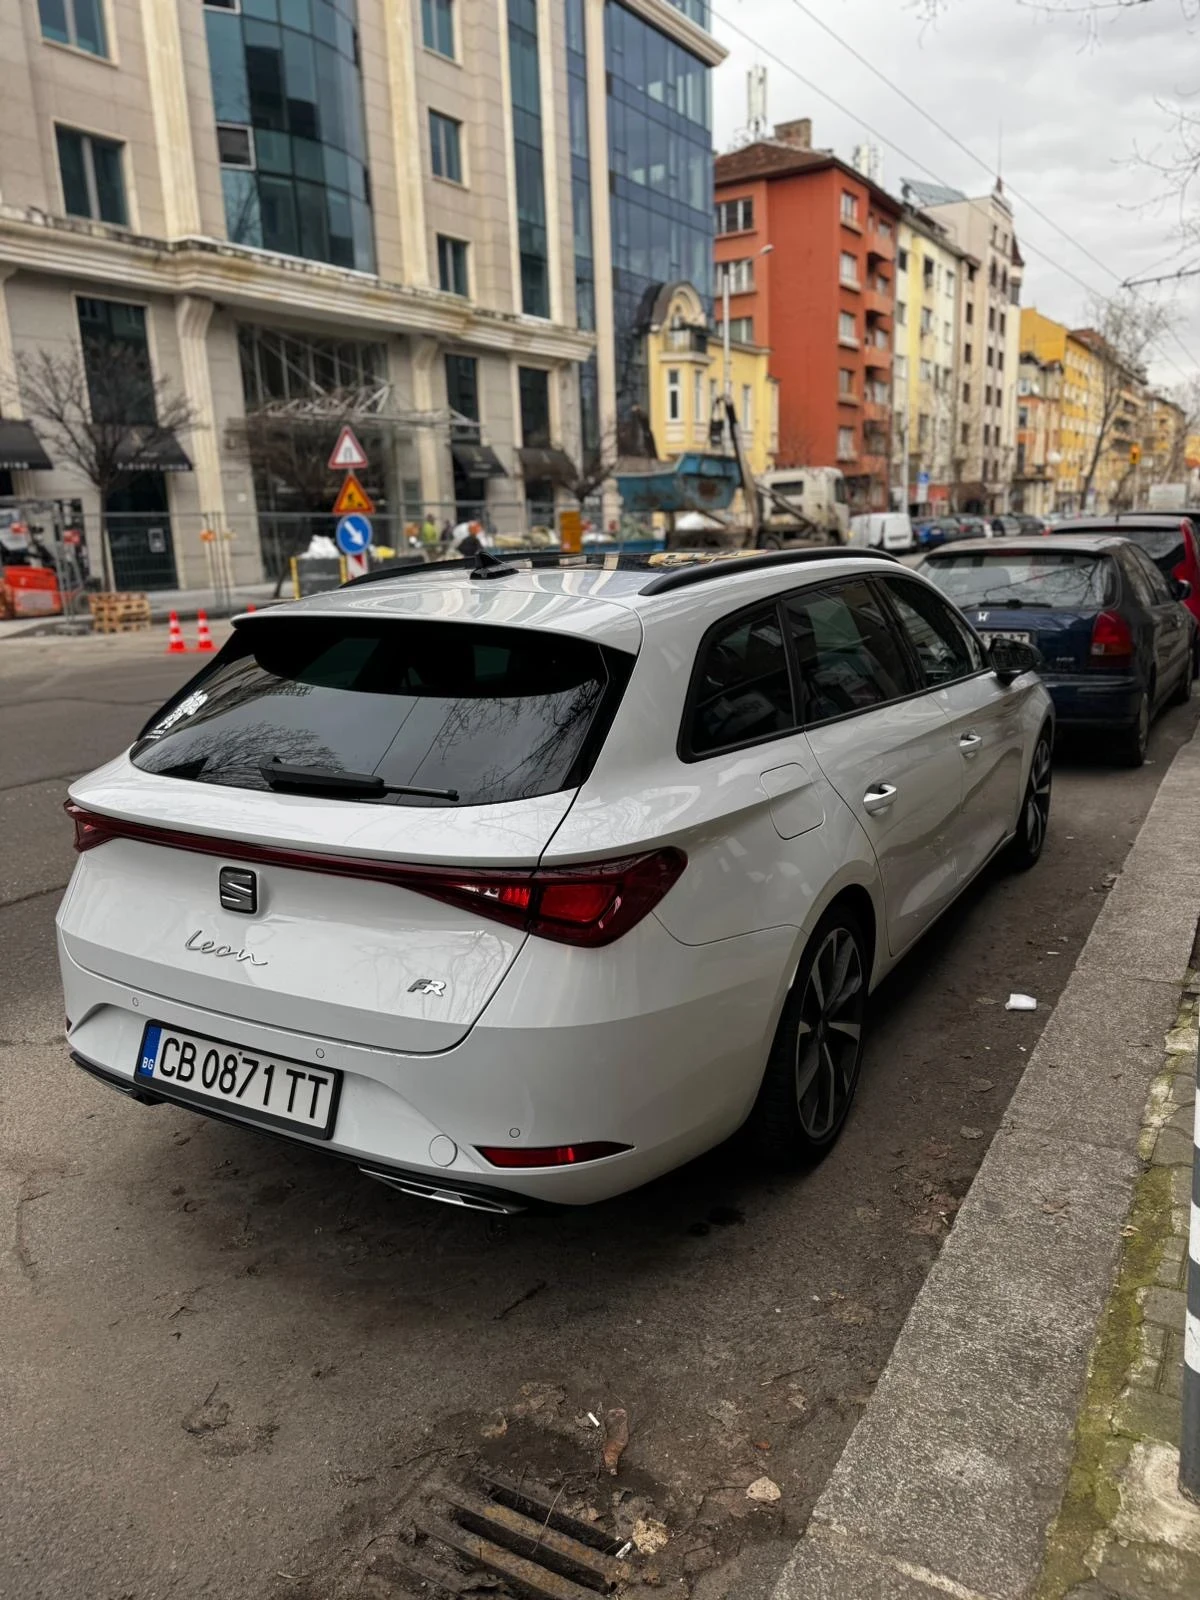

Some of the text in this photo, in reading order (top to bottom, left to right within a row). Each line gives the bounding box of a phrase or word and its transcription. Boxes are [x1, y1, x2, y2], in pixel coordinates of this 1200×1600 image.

[185, 929, 268, 966] Leon
[407, 978, 447, 997] FR
[142, 1056, 154, 1070] BG
[159, 1037, 328, 1119] CB 0871 TT
